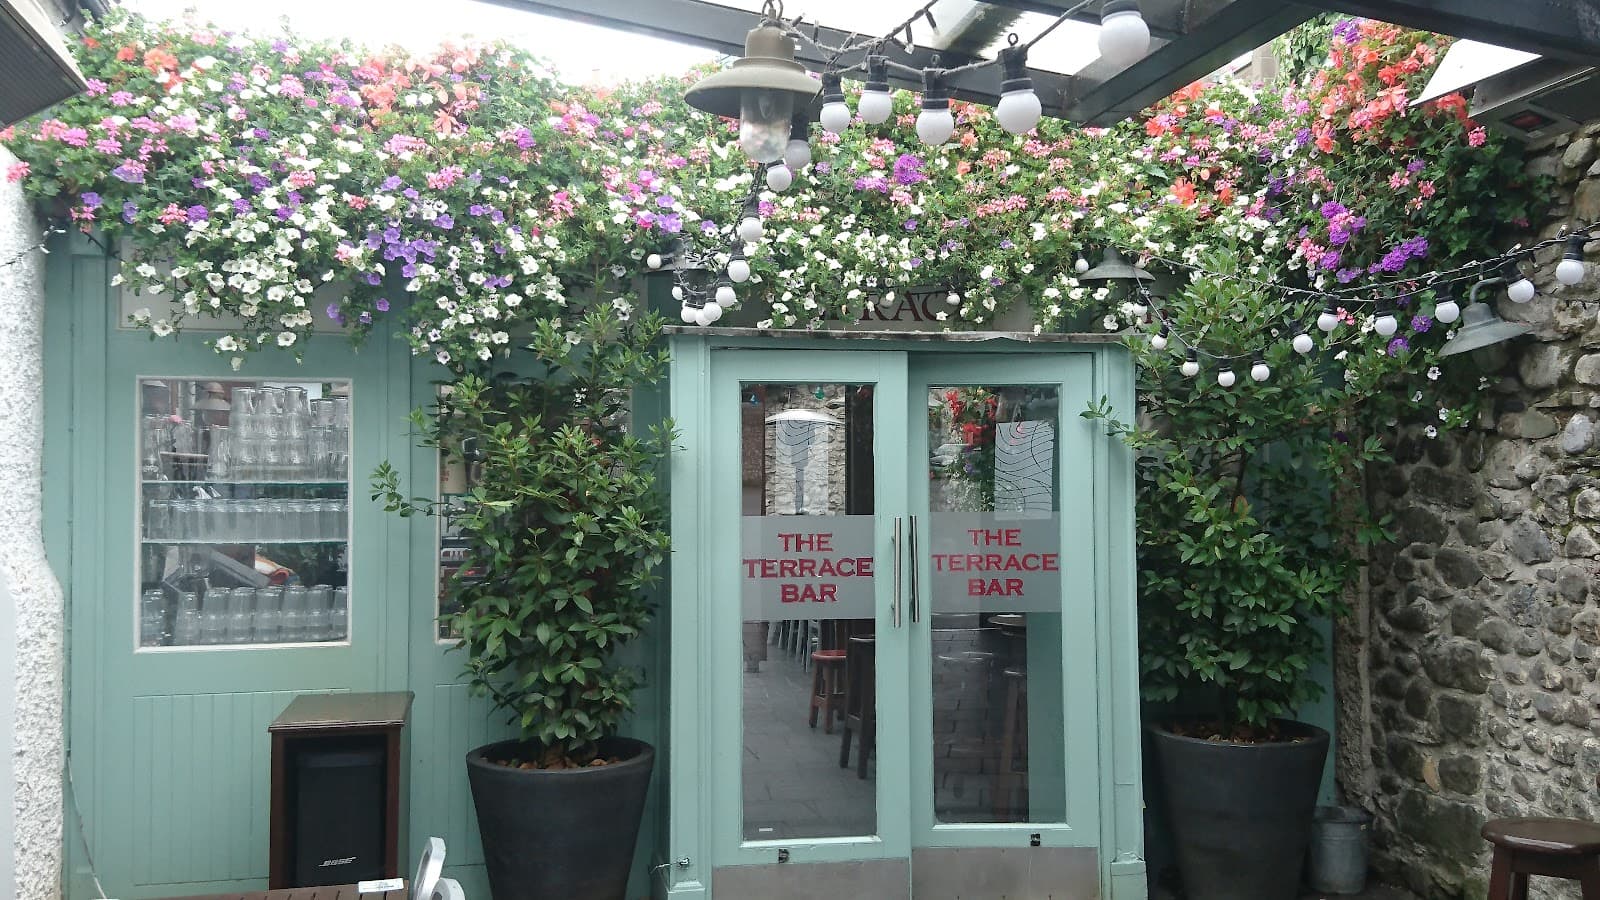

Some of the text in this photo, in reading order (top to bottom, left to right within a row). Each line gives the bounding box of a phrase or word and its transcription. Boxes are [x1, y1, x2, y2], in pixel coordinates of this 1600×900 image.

[777, 533, 833, 552] THE
[967, 529, 1022, 546] THE
[742, 557, 874, 578] TERRACE
[931, 552, 1059, 572] TERRACE
[780, 583, 838, 603] BAR
[967, 578, 1024, 597] BAR
[318, 856, 357, 867] BOSE
